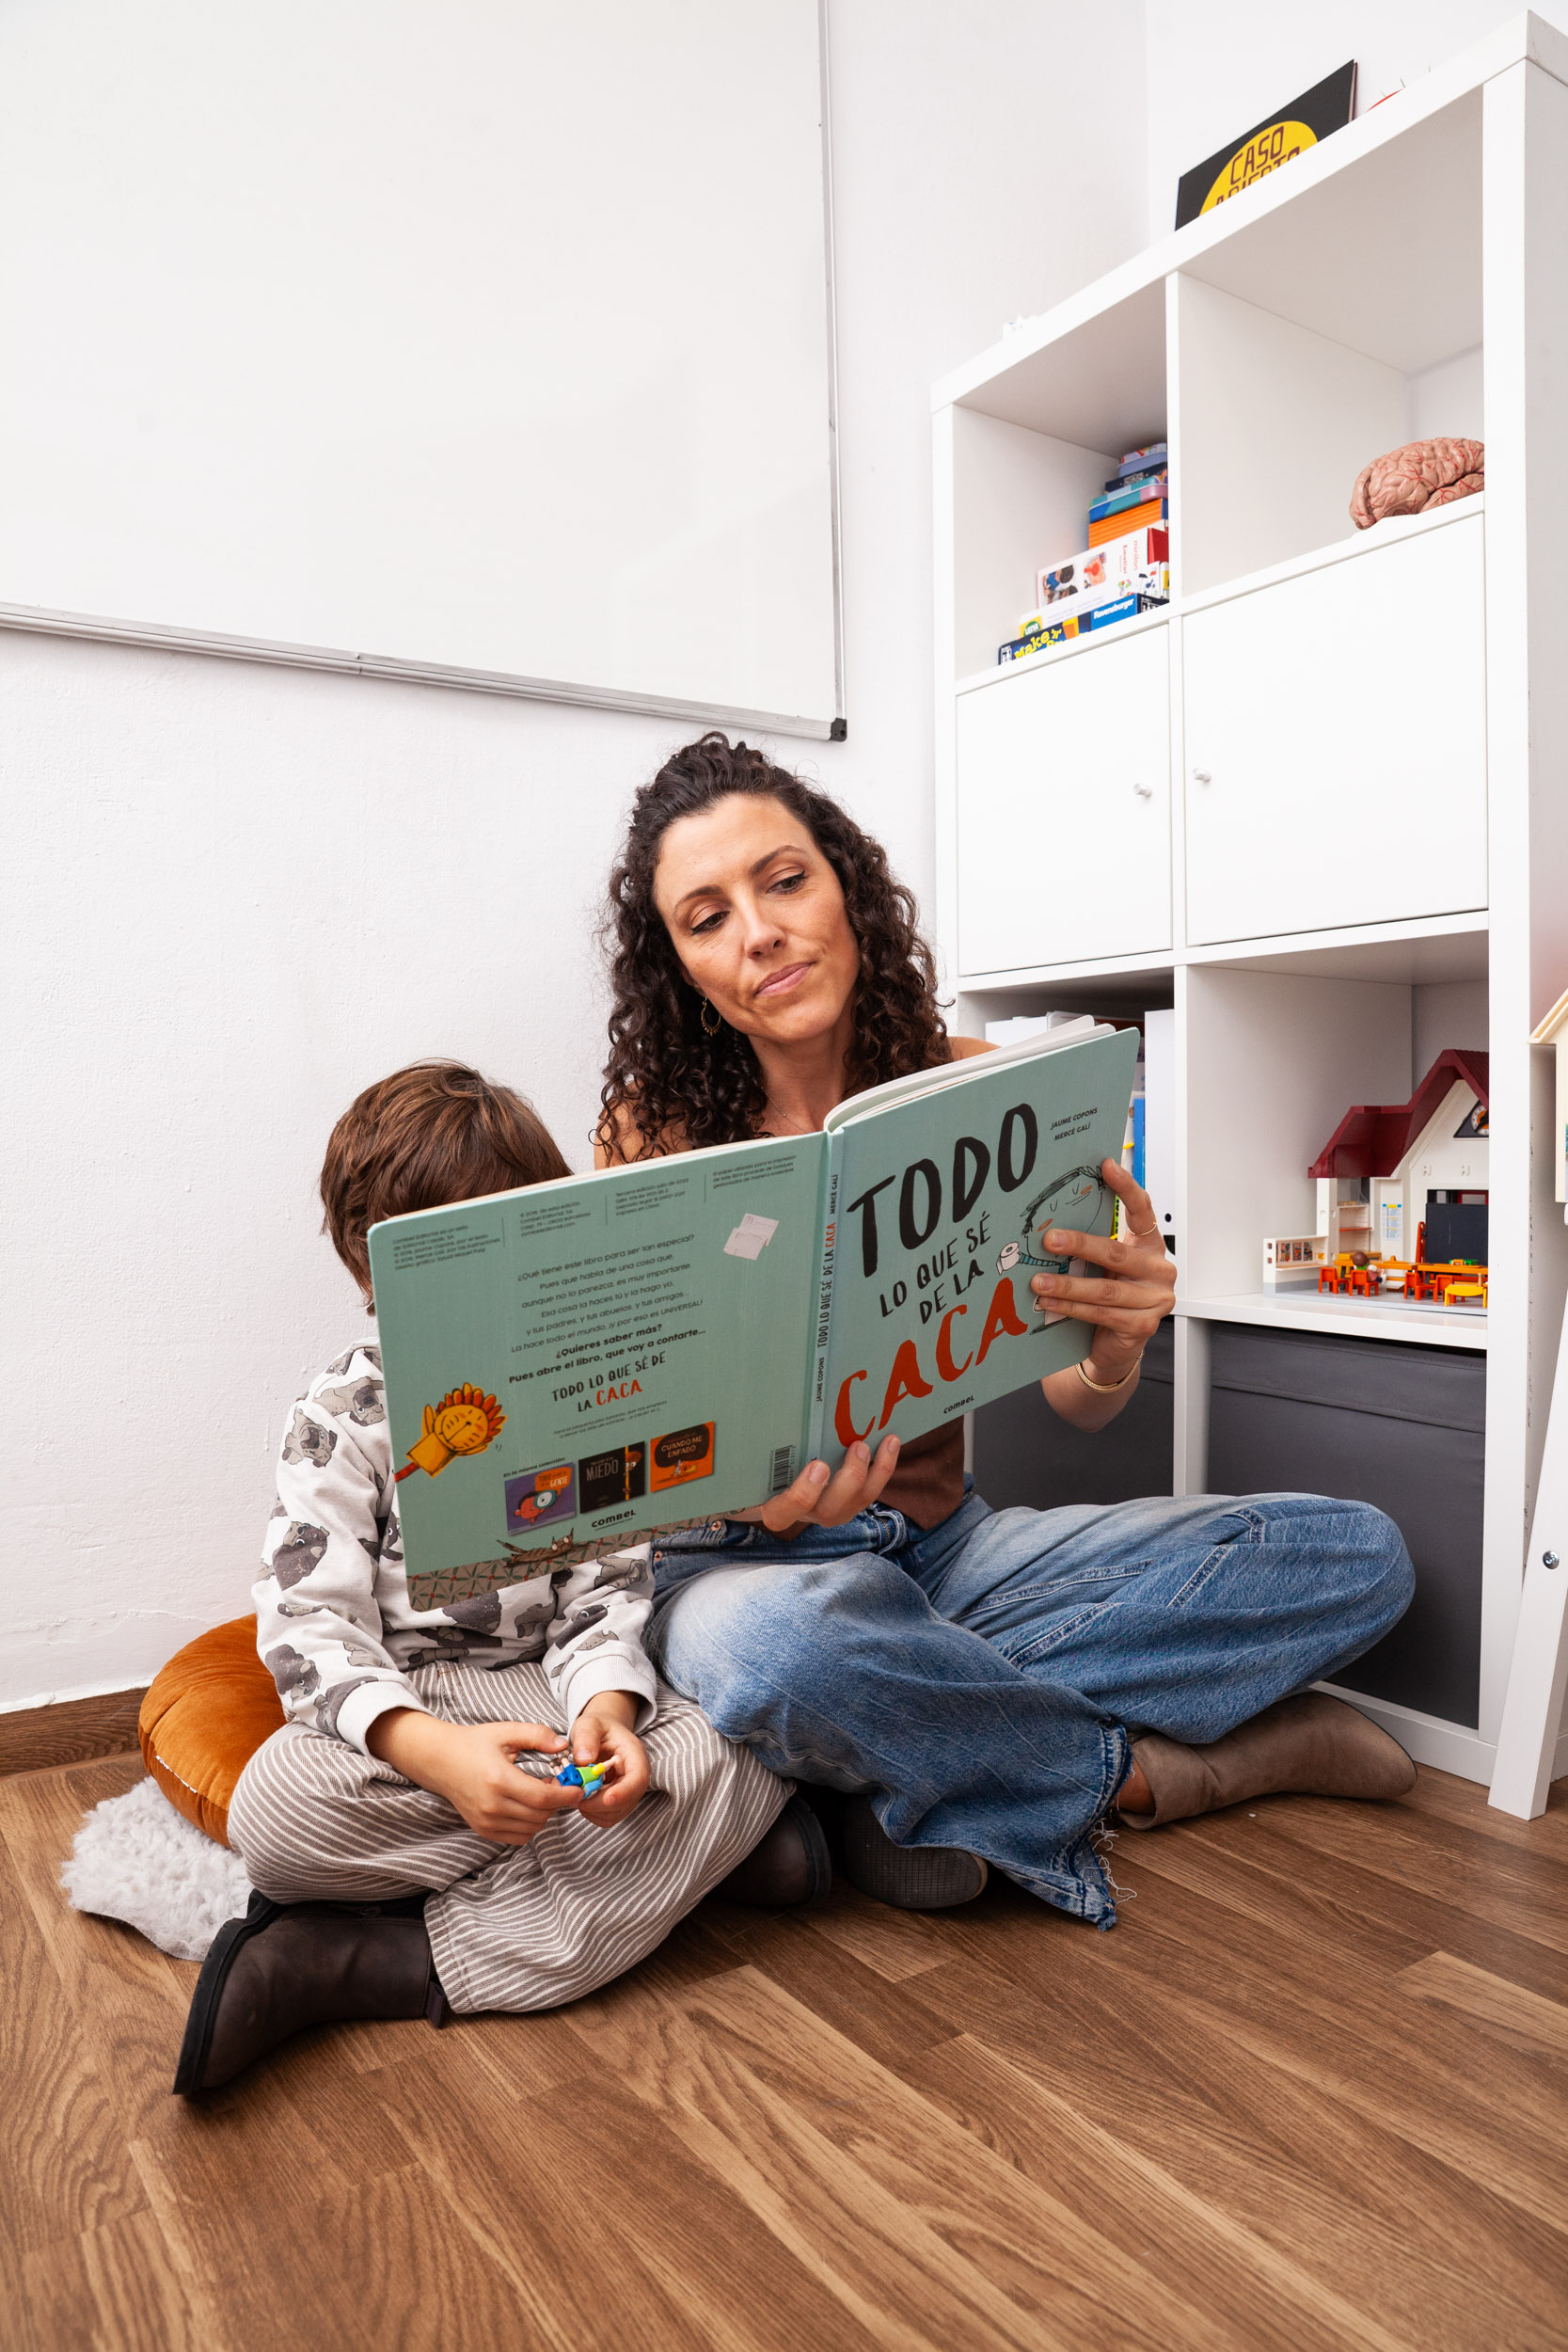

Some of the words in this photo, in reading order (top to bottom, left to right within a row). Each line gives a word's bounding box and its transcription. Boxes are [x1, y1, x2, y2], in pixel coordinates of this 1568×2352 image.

[1230, 126, 1284, 185] CASO
[1094, 598, 1133, 619] Ravensburger
[1014, 631, 1050, 659] Make
[1050, 1117, 1072, 1130] JAUME
[1073, 1107, 1098, 1122] COPONS
[1077, 1121, 1091, 1134] GALÍ
[847, 1104, 1038, 1278] TODO
[825, 1222, 836, 1248] CACA
[517, 1270, 540, 1281] ¿Qué
[542, 1266, 562, 1275] tiene
[564, 1262, 582, 1270] este
[584, 1257, 603, 1265] libro
[605, 1251, 626, 1262] para
[657, 1234, 694, 1248] especial?
[824, 1249, 833, 1262] LA
[879, 1281, 907, 1317] LO
[917, 1238, 958, 1289] QUE
[966, 1211, 990, 1253] SÉ
[540, 1280, 560, 1290] Pues
[562, 1277, 578, 1285] que
[579, 1270, 604, 1279] habla
[636, 1258, 656, 1267] cosa
[823, 1263, 833, 1276] DE
[820, 1279, 832, 1290] SÉ
[920, 1283, 947, 1324] DE
[954, 1259, 985, 1295] LA
[521, 1296, 554, 1308] aunque
[558, 1304, 578, 1313] cosa
[589, 1295, 613, 1306] haces
[640, 1284, 661, 1294] hago
[820, 1293, 831, 1310] QUE
[523, 1341, 545, 1349] hace
[546, 1335, 566, 1343] todo
[617, 1318, 632, 1327] por
[661, 1299, 703, 1315] UNIVERSAL!
[820, 1311, 830, 1323] LO
[556, 1341, 601, 1359] ¿Quieres
[604, 1332, 634, 1345] saber
[636, 1324, 662, 1337] más?
[817, 1326, 828, 1348] TODO
[509, 1372, 533, 1384] Pues
[536, 1365, 562, 1376] abre
[564, 1360, 574, 1369] el
[577, 1355, 603, 1366] libro,
[606, 1348, 625, 1359] que
[627, 1343, 645, 1352] voy
[657, 1329, 705, 1345] contarte...
[834, 1277, 1028, 1448] CACA
[552, 1381, 584, 1402] TODO
[589, 1375, 603, 1389] LO
[609, 1363, 631, 1381] QUE
[636, 1355, 649, 1372] SÉ
[652, 1351, 666, 1367] DE
[578, 1400, 592, 1412] LA
[596, 1379, 642, 1406] CACA
[661, 1439, 691, 1453] CUANDO
[692, 1435, 703, 1443] ME
[668, 1445, 697, 1458] ENFADO
[549, 1476, 568, 1488] GENTE
[586, 1460, 619, 1482] MIEDO
